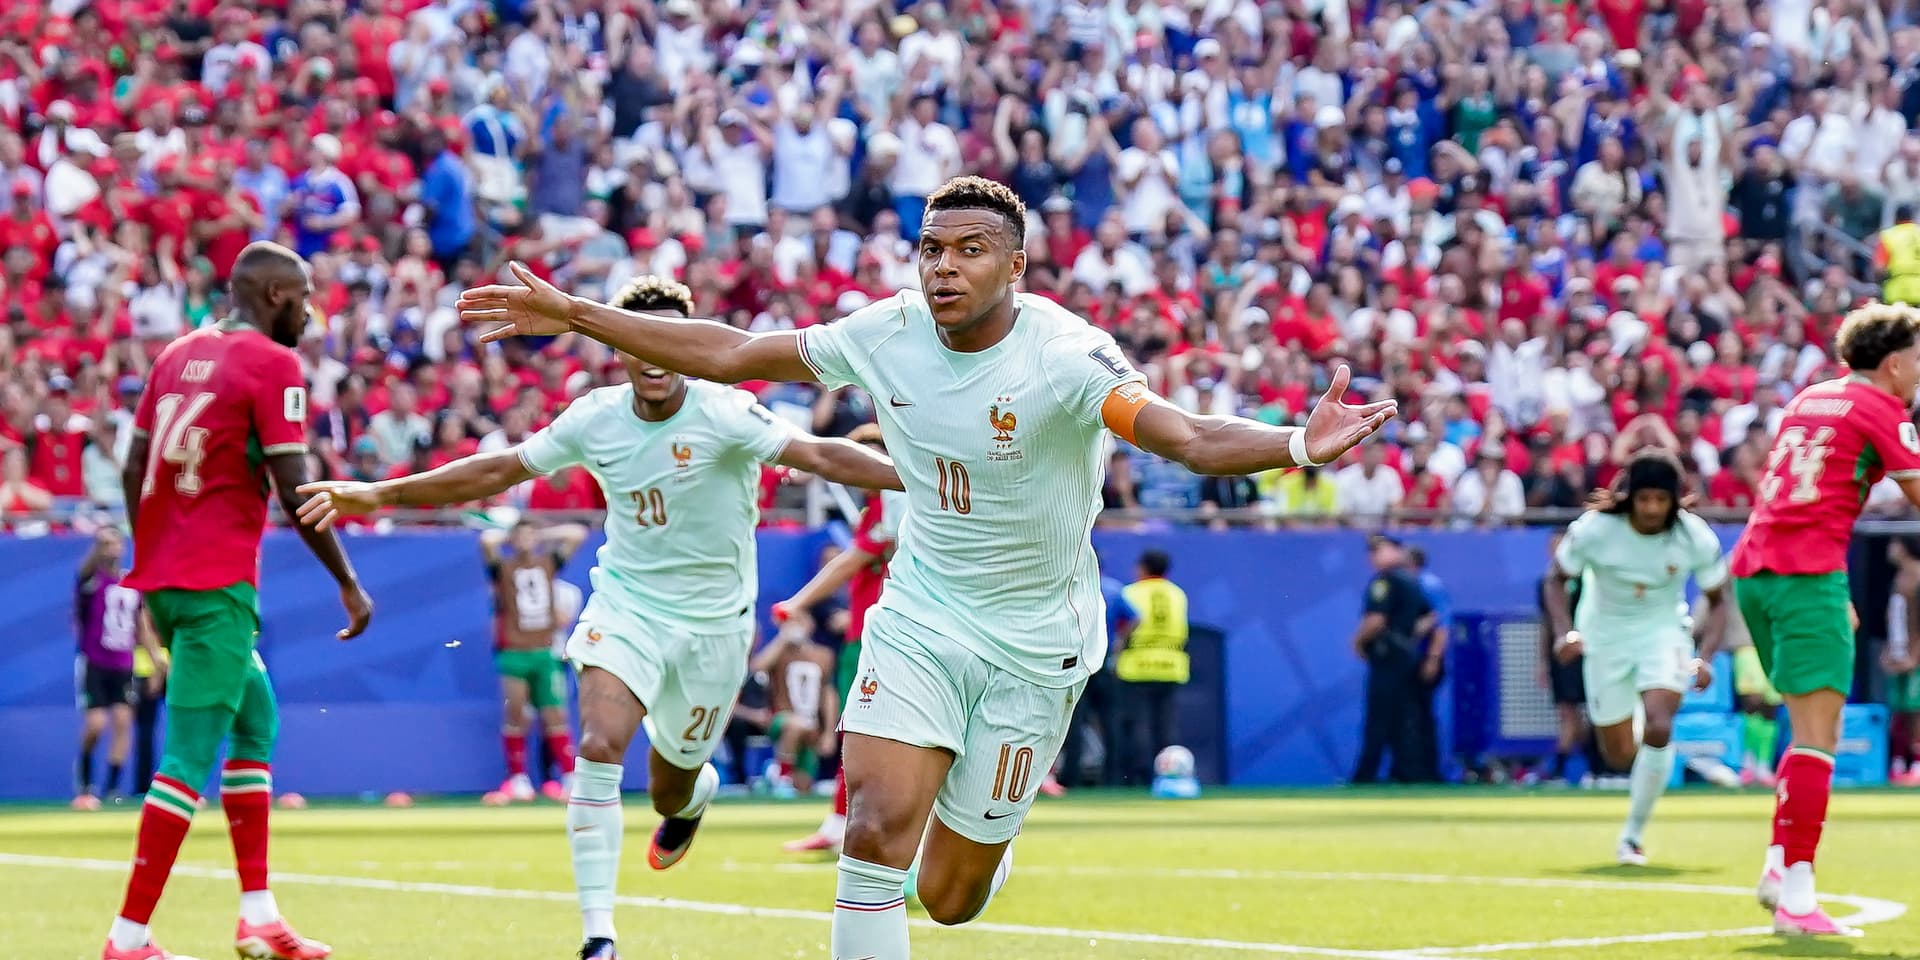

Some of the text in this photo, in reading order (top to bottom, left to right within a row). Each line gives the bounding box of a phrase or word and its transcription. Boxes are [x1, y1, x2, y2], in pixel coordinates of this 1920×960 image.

[141, 392, 217, 498] 14
[630, 487, 668, 527] 20
[935, 457, 973, 516] 10
[682, 704, 721, 742] 20
[991, 743, 1034, 804] 10
